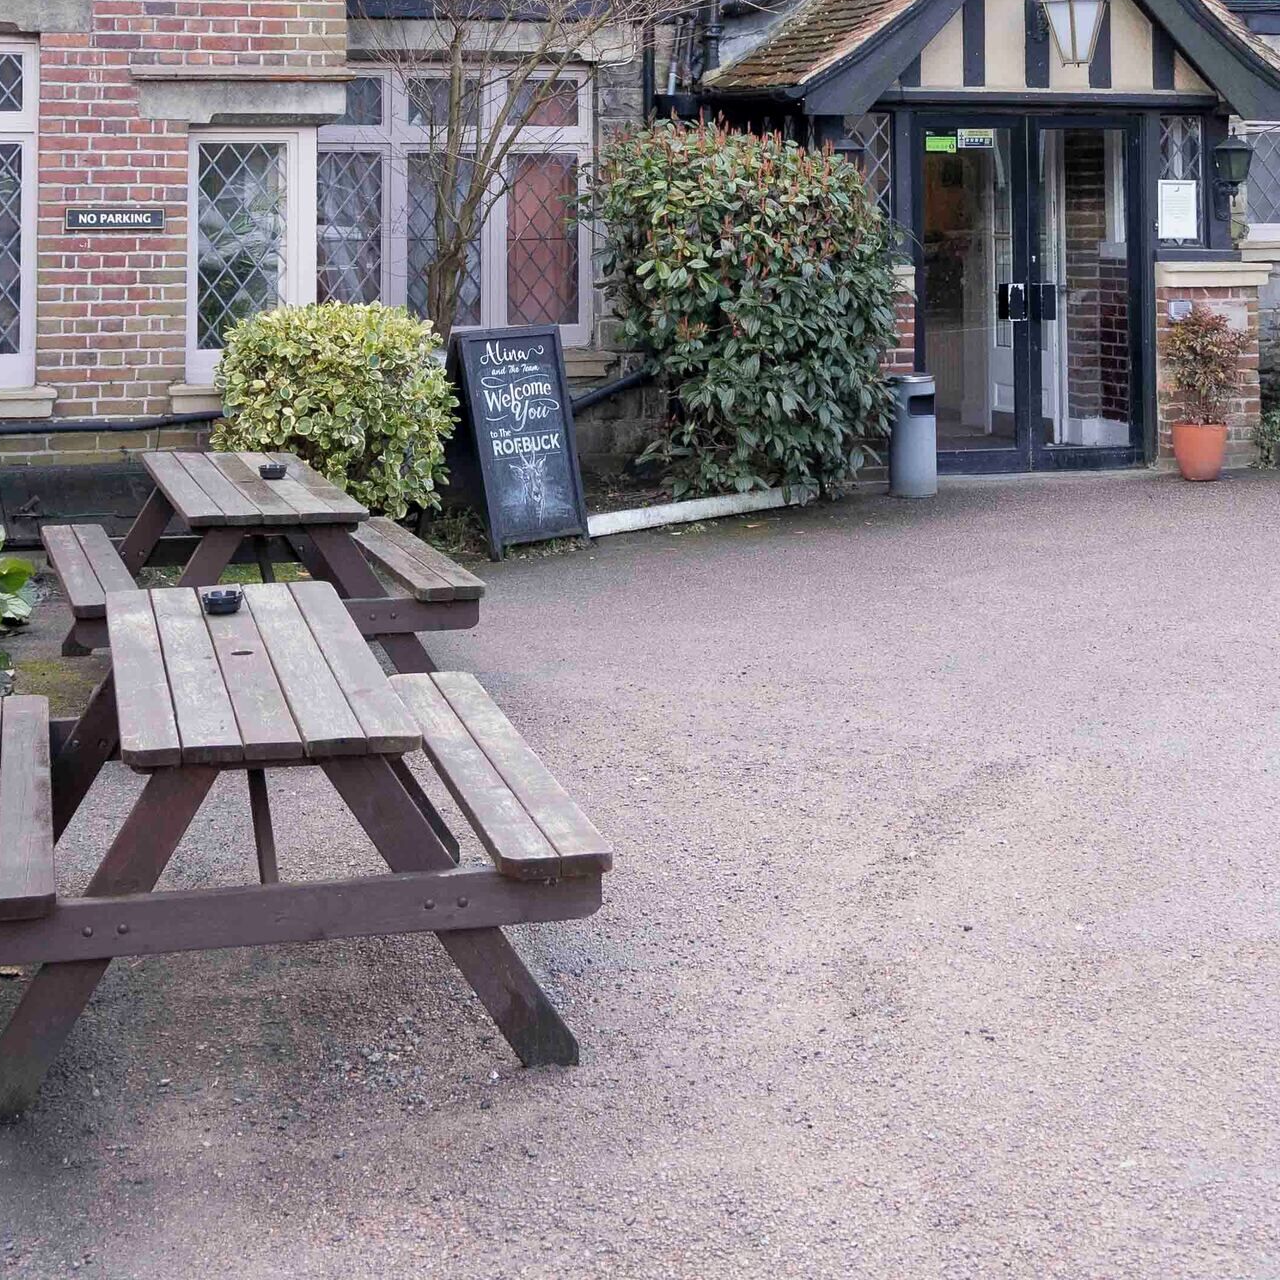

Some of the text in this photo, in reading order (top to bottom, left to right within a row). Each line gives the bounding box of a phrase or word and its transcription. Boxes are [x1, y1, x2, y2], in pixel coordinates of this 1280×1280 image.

[78, 213, 151, 224] NO PARKING
[480, 341, 543, 365] Alina
[491, 363, 540, 376] and The Team
[483, 382, 552, 412] Welcome
[510, 400, 553, 432] You
[489, 428, 512, 439] to The
[492, 433, 561, 456] ROEBUCK
